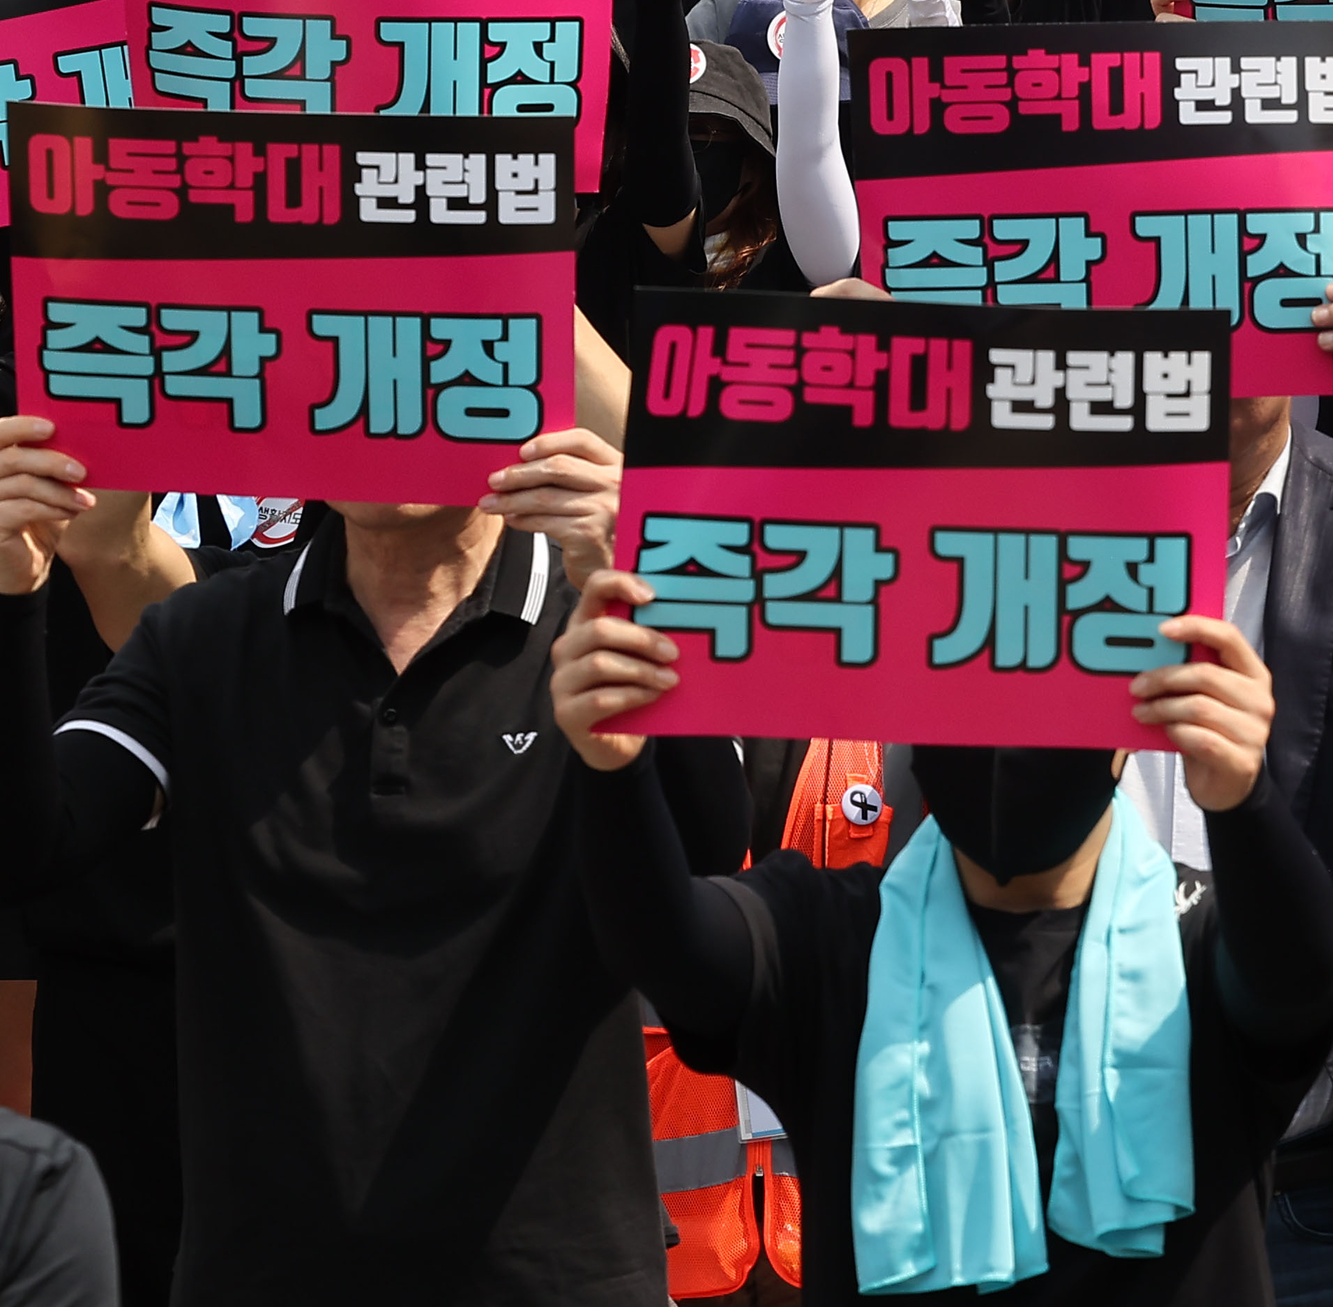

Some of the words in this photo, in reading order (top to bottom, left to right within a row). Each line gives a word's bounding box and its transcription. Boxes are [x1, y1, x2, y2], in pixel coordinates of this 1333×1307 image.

[870, 48, 1161, 136] 아동학대
[28, 134, 341, 224] 아동학대
[355, 151, 557, 224] 관련법
[40, 300, 279, 430] 즉각
[310, 313, 544, 442] 개정
[647, 324, 973, 432] 아동학대
[986, 347, 1213, 434] 관련법
[632, 513, 900, 667] 즉각
[928, 525, 1193, 674] 개정
